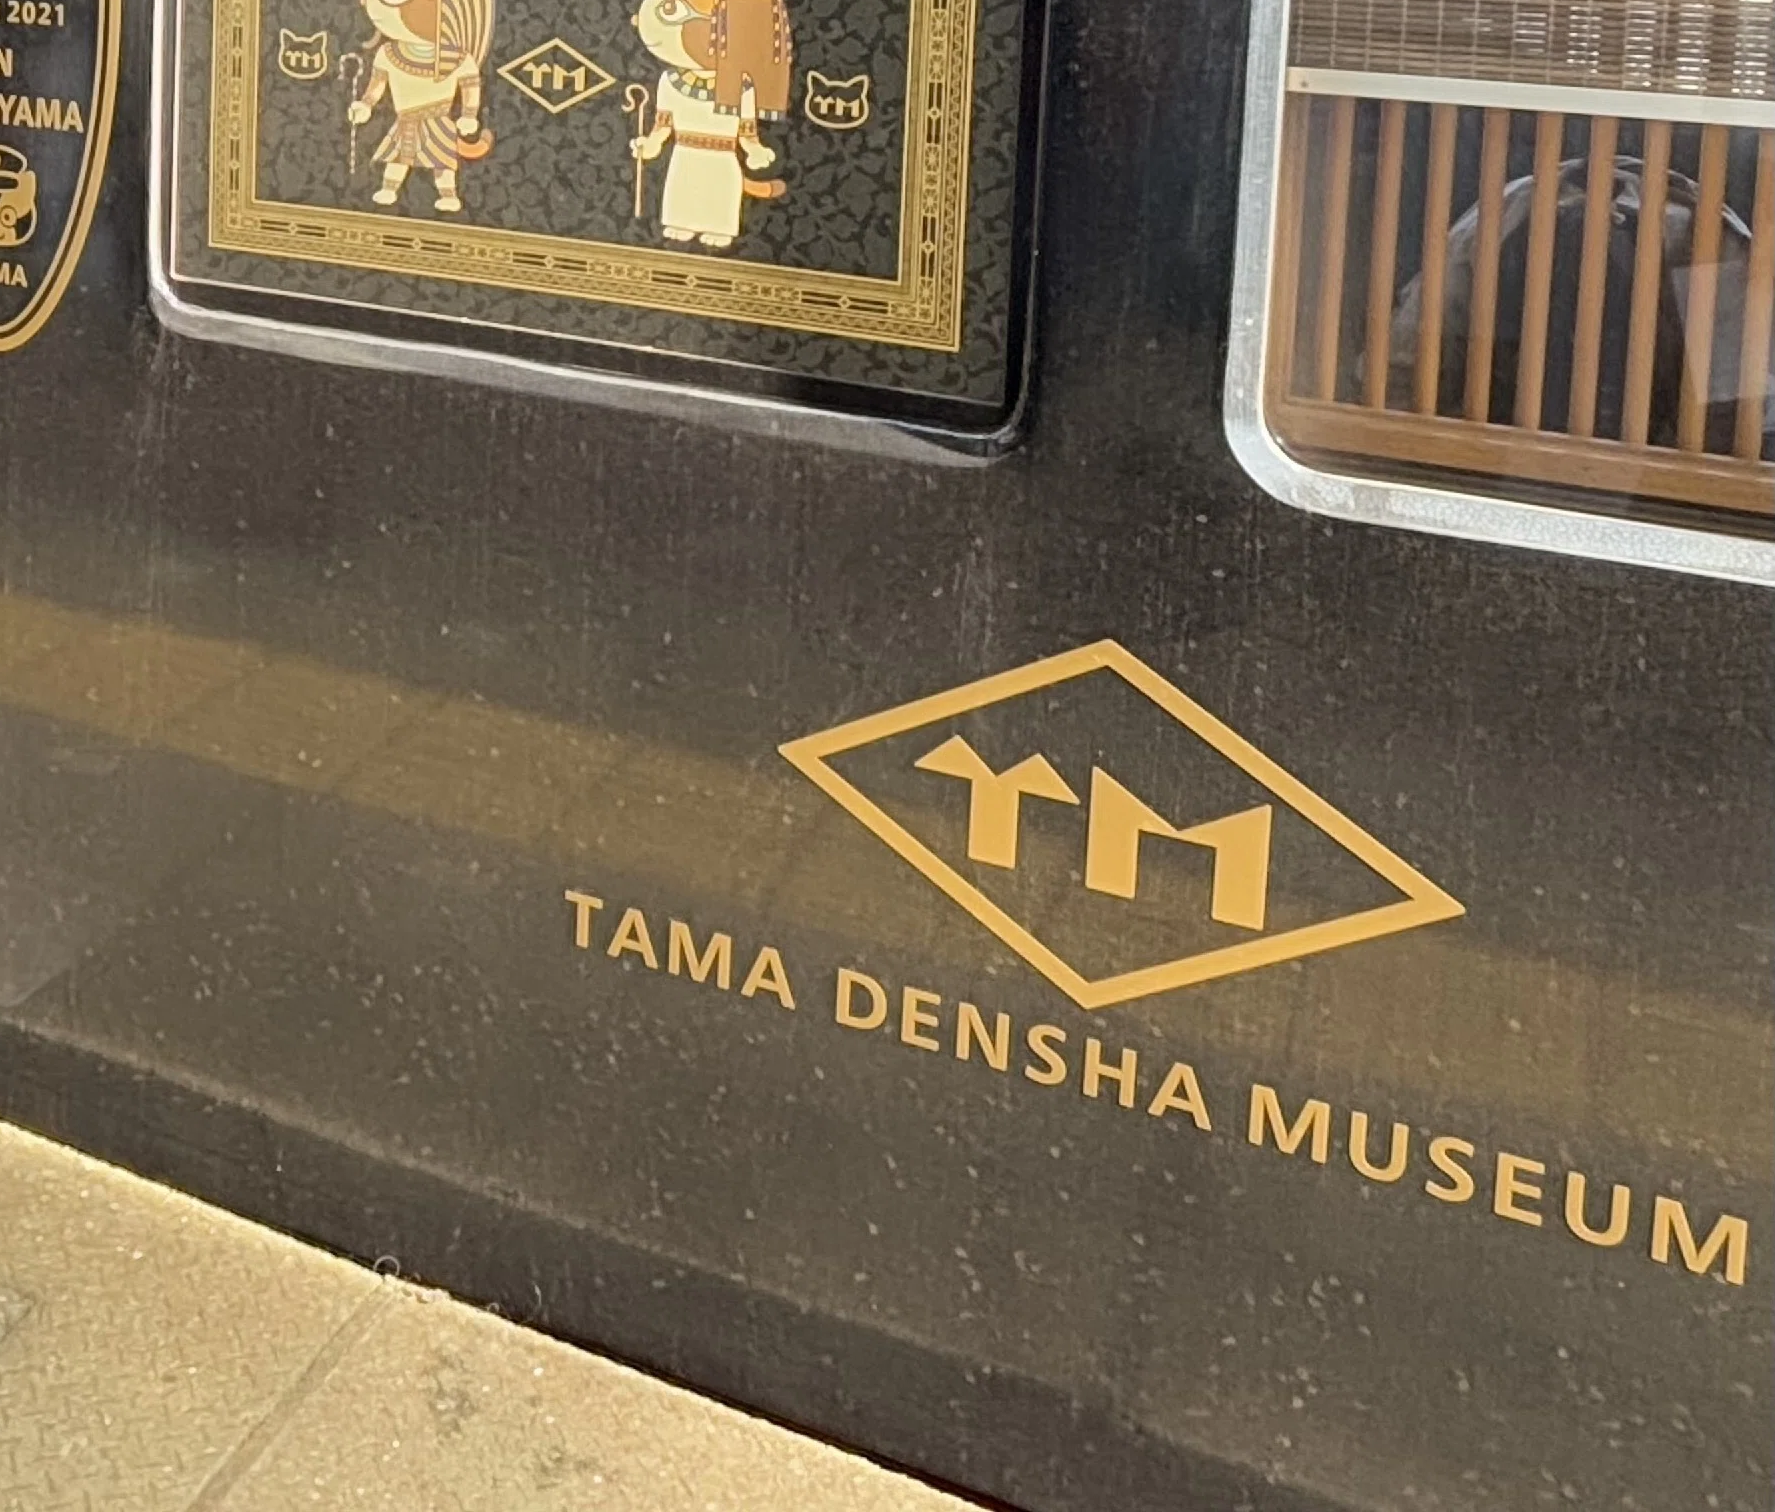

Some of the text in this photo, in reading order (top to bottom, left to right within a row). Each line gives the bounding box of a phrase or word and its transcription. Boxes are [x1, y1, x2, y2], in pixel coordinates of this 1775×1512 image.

[6, 0, 65, 27] 2021
[564, 889, 1749, 1285] TAMA DENSHA MUSEUM
